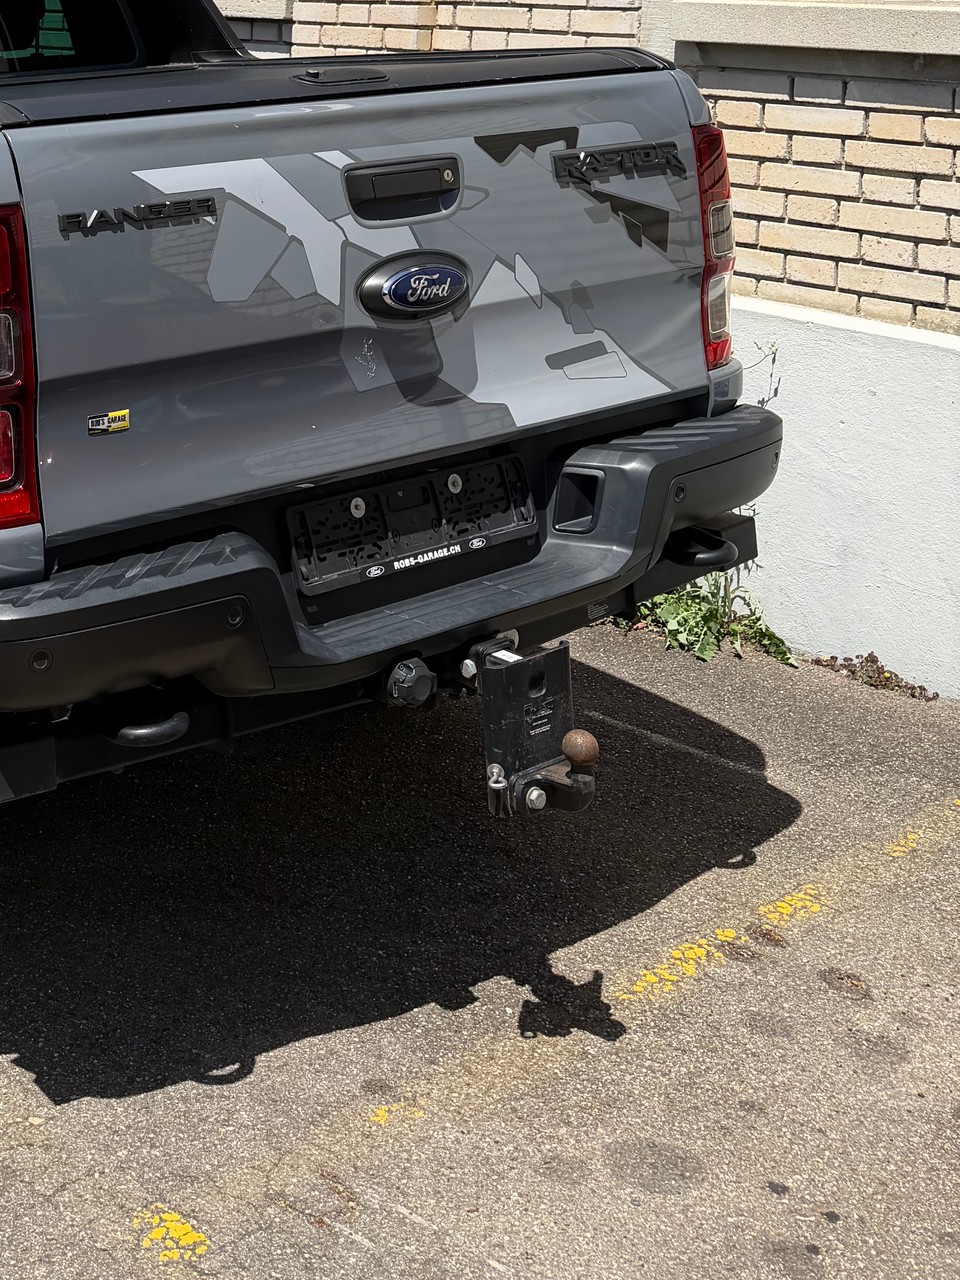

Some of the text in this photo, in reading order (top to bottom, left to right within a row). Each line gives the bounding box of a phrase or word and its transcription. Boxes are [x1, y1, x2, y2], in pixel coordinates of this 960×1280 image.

[552, 141, 687, 186] RAPTOR
[58, 197, 218, 232] RANGER
[407, 273, 451, 302] Ford
[393, 544, 461, 570] ROBS-GARAGE.CH
